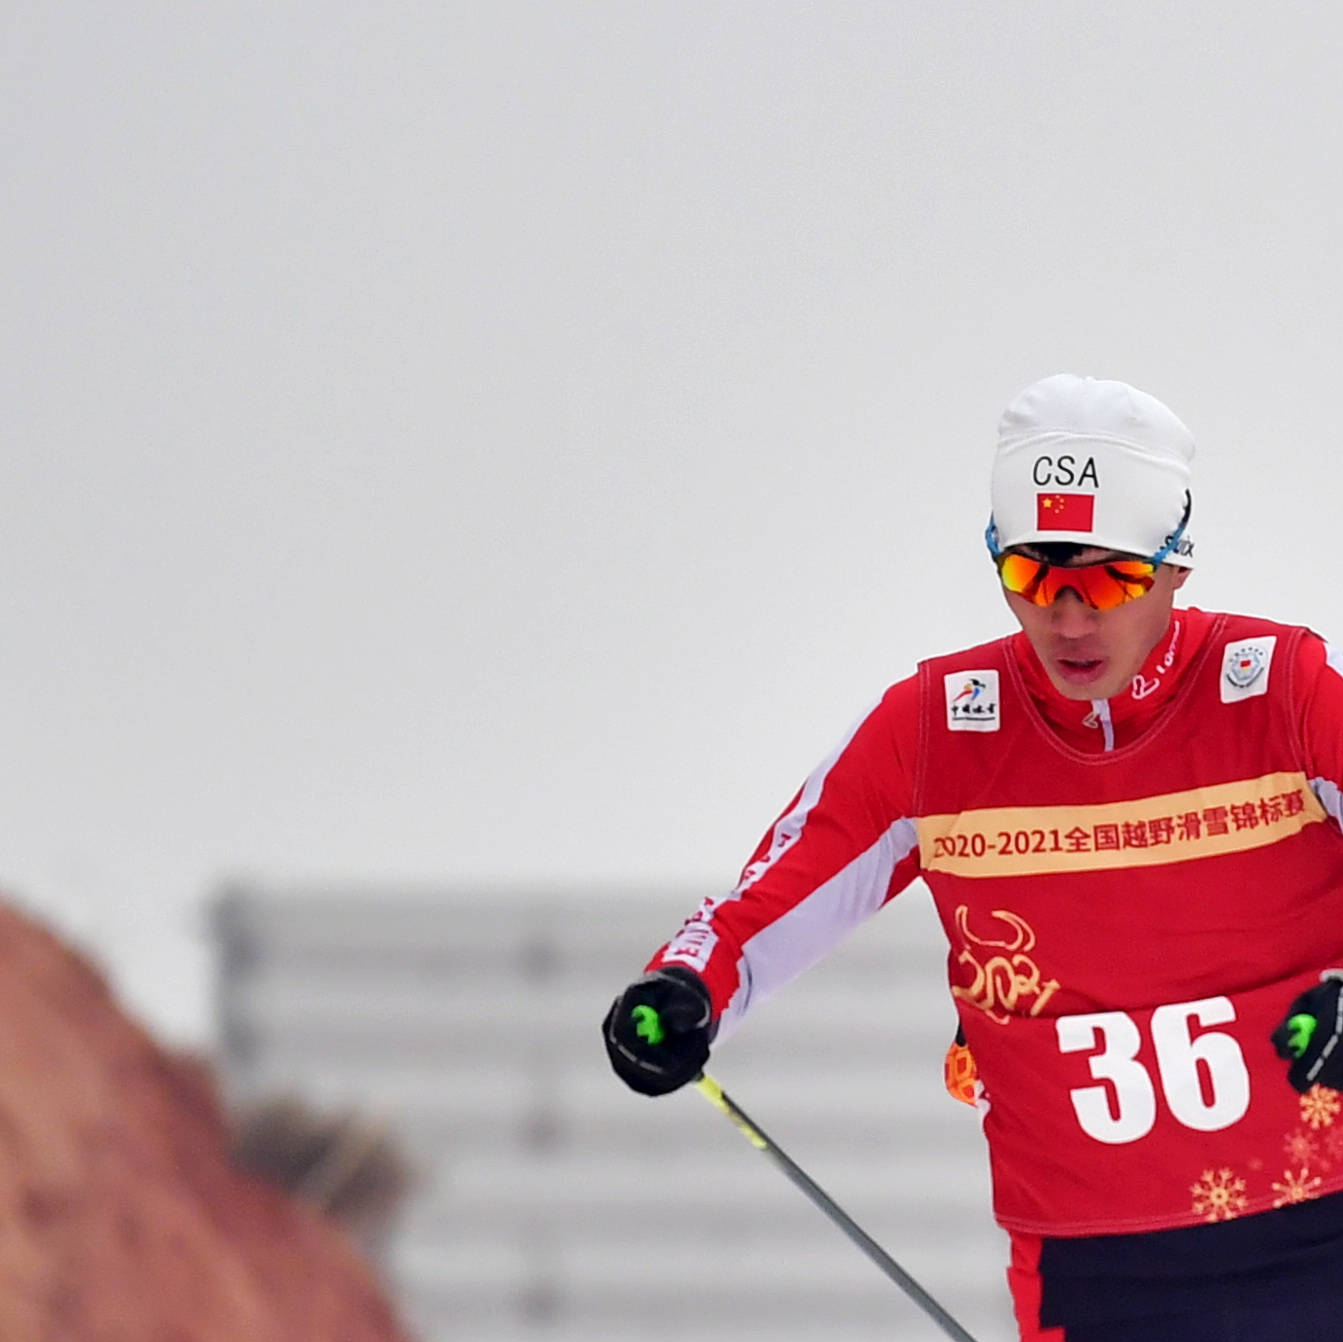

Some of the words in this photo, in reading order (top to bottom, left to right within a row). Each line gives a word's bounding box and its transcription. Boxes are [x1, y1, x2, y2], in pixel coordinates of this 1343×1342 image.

[1033, 455, 1099, 488] CSA
[933, 788, 1304, 859] 2020-2021全国越野滑雪锦标赛
[1055, 995, 1250, 1144] 36
